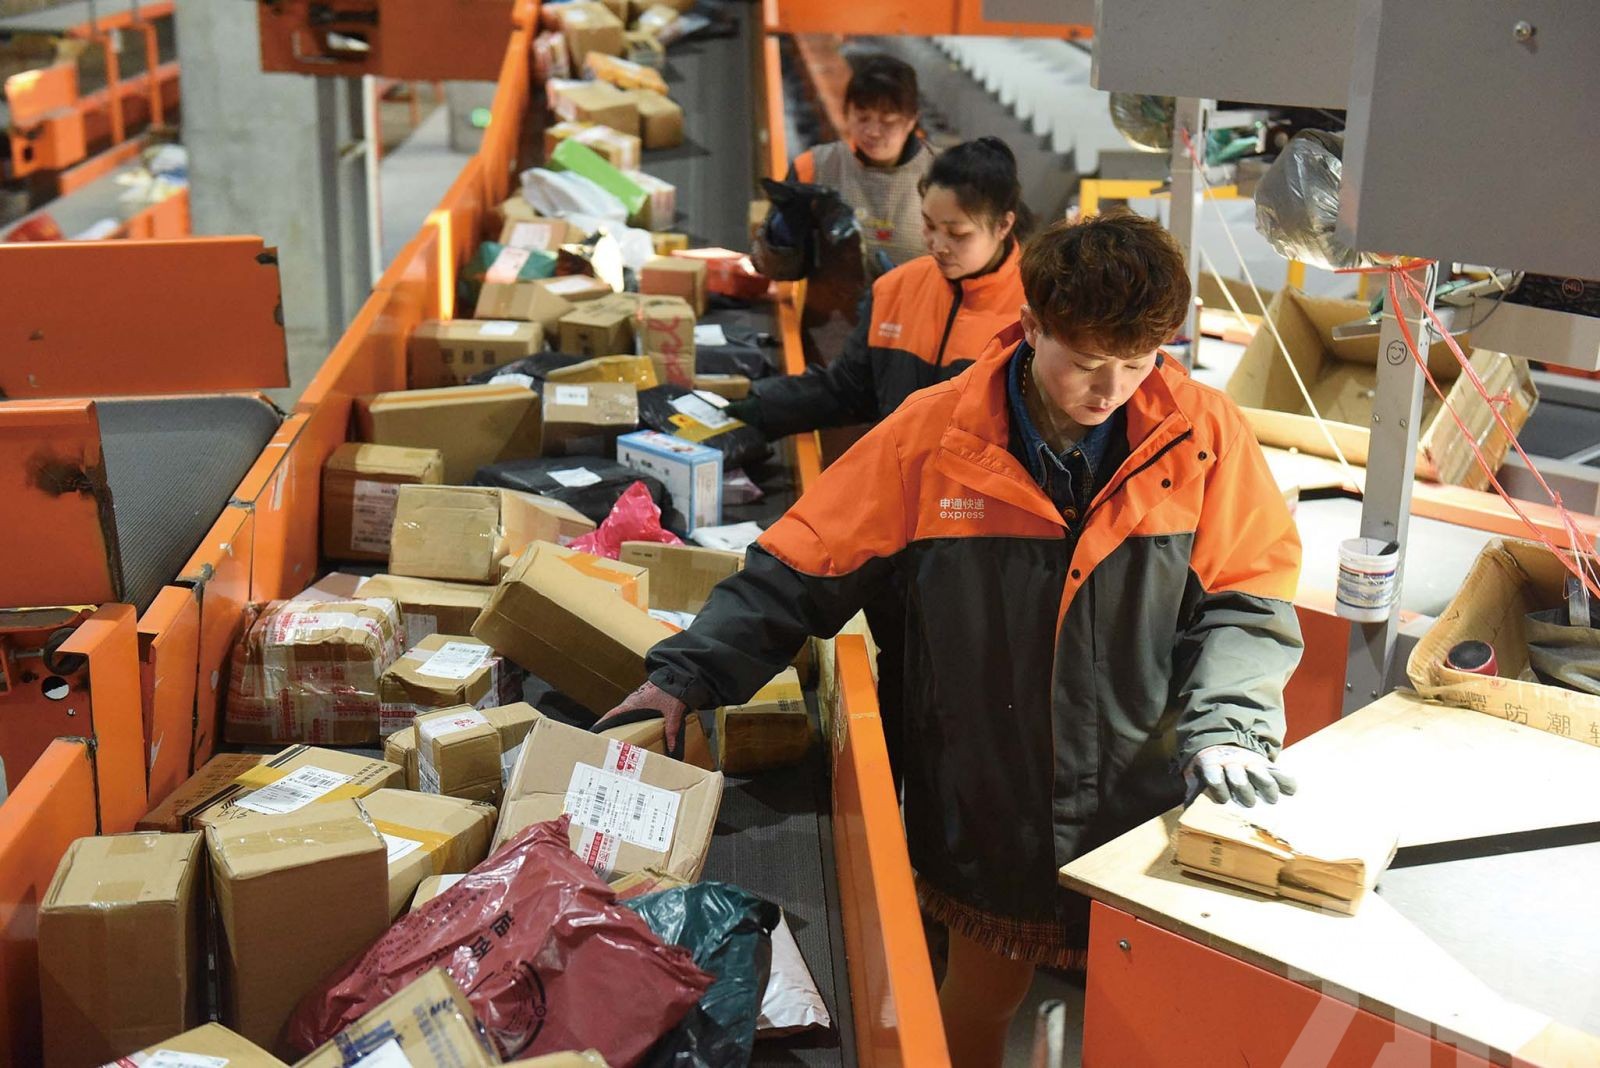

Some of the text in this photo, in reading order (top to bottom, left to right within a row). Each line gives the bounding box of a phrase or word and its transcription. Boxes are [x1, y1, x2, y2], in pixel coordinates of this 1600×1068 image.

[939, 498, 985, 510] 申通快递
[939, 511, 985, 520] express
